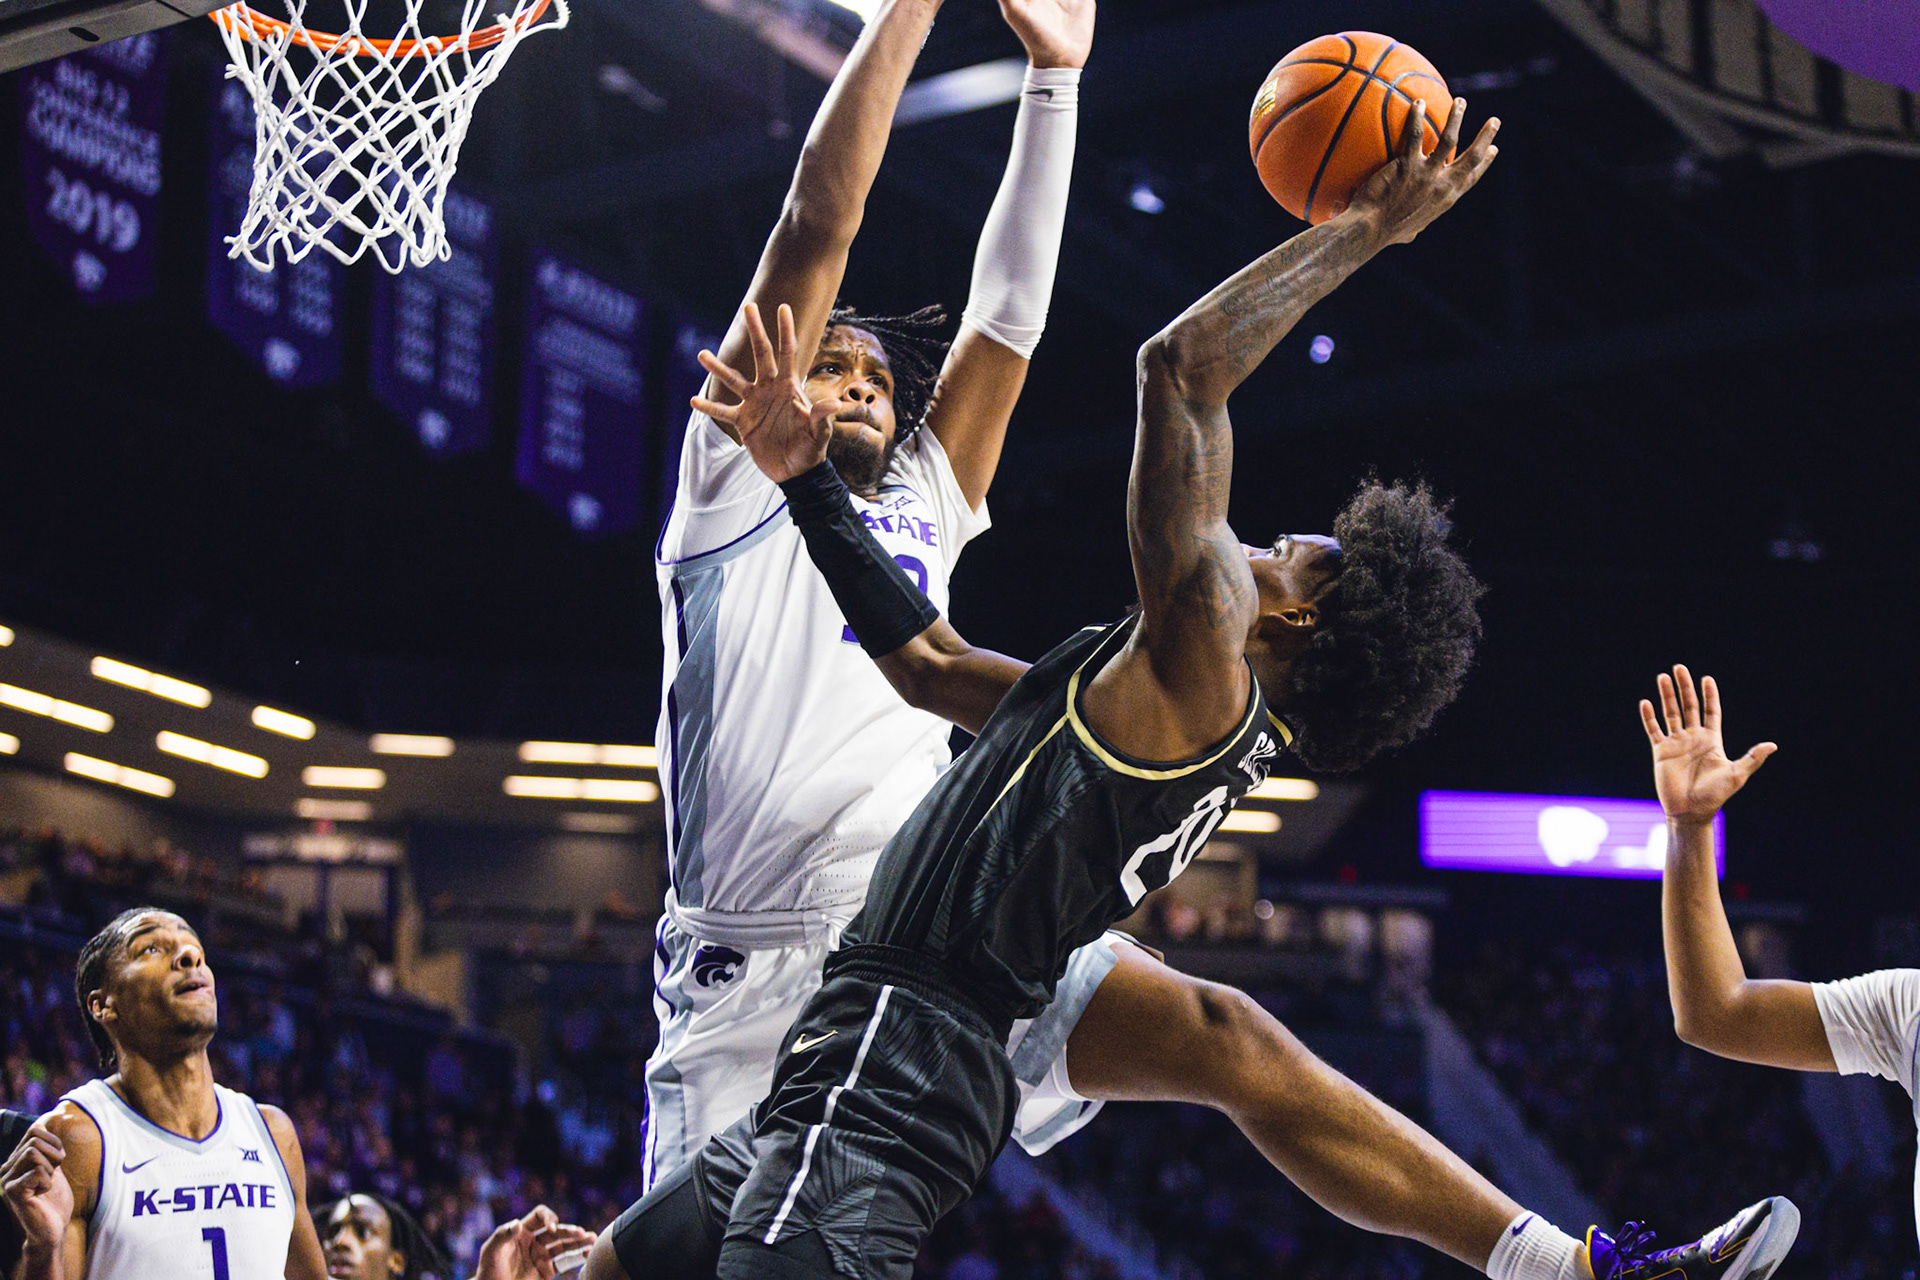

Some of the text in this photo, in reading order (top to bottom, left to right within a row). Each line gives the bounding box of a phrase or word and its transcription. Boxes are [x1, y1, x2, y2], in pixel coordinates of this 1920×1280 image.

[45, 167, 141, 252] 2019
[859, 509, 937, 547] STATE
[132, 1183, 276, 1217] K-STATE
[201, 1227, 230, 1280] 1
